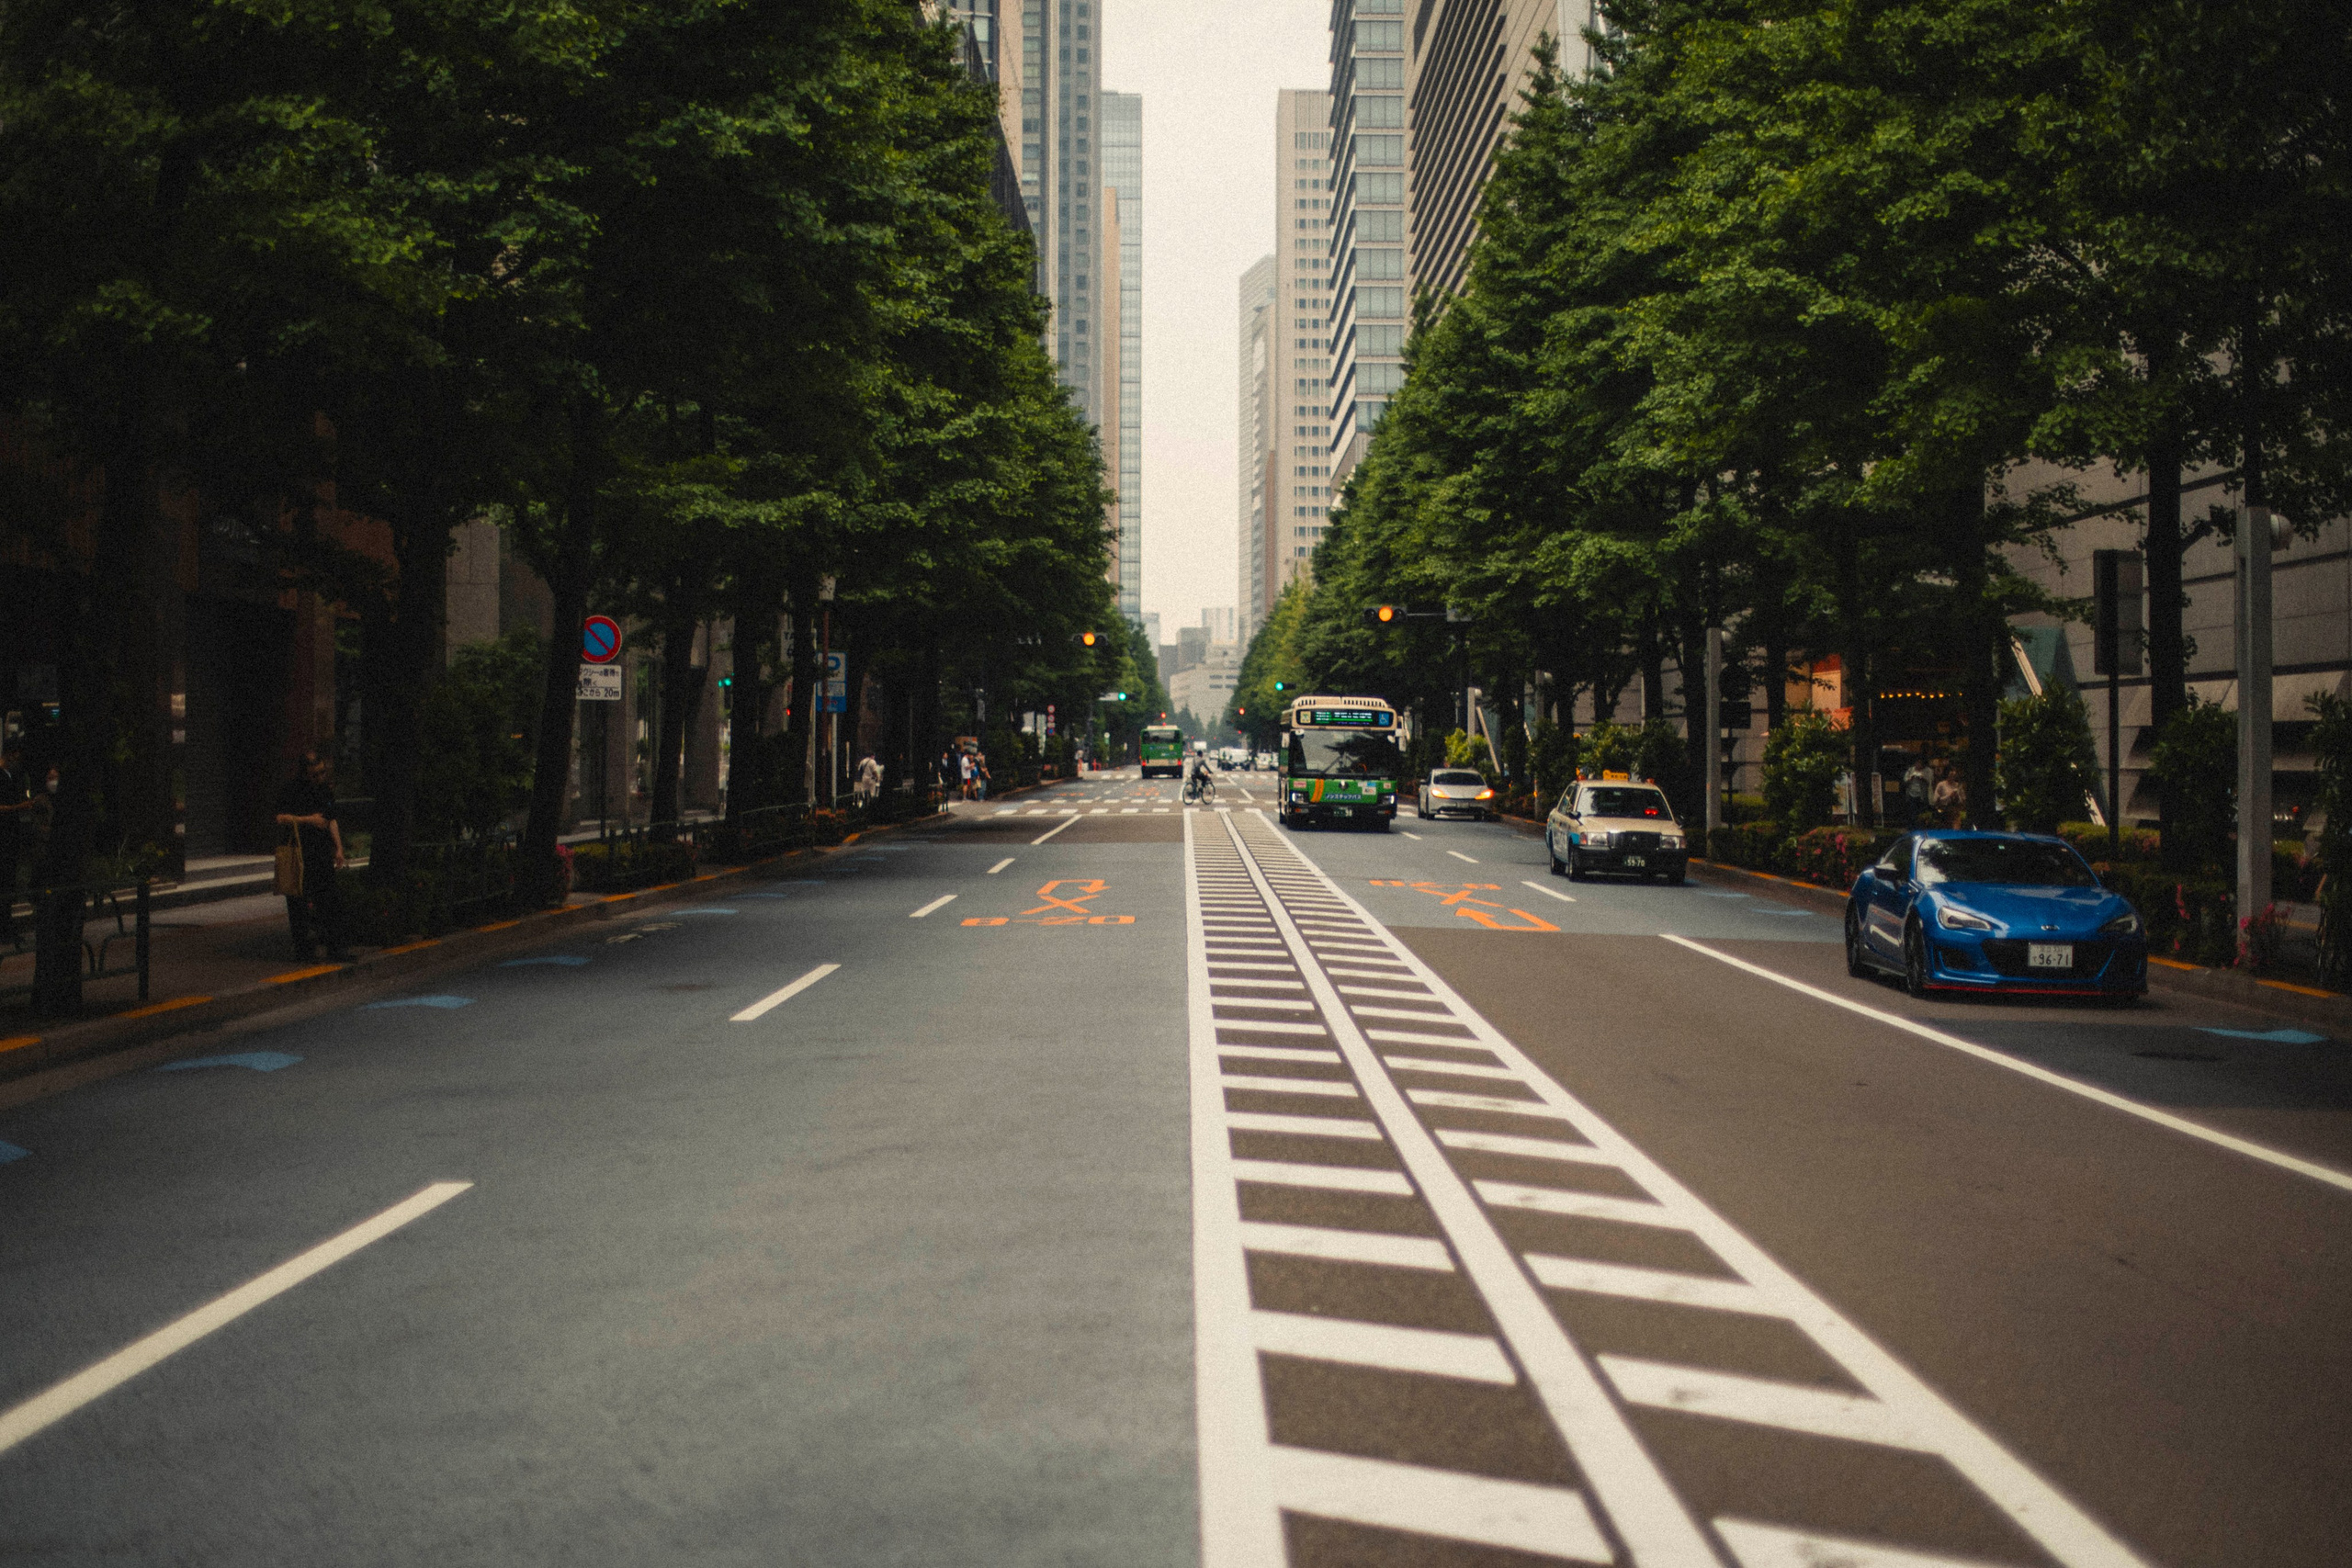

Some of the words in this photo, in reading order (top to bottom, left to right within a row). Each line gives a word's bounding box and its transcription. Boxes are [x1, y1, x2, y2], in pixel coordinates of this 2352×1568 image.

[581, 678, 597, 687] 除く
[604, 688, 619, 697] 20m
[2039, 953, 2068, 965] 96-71
